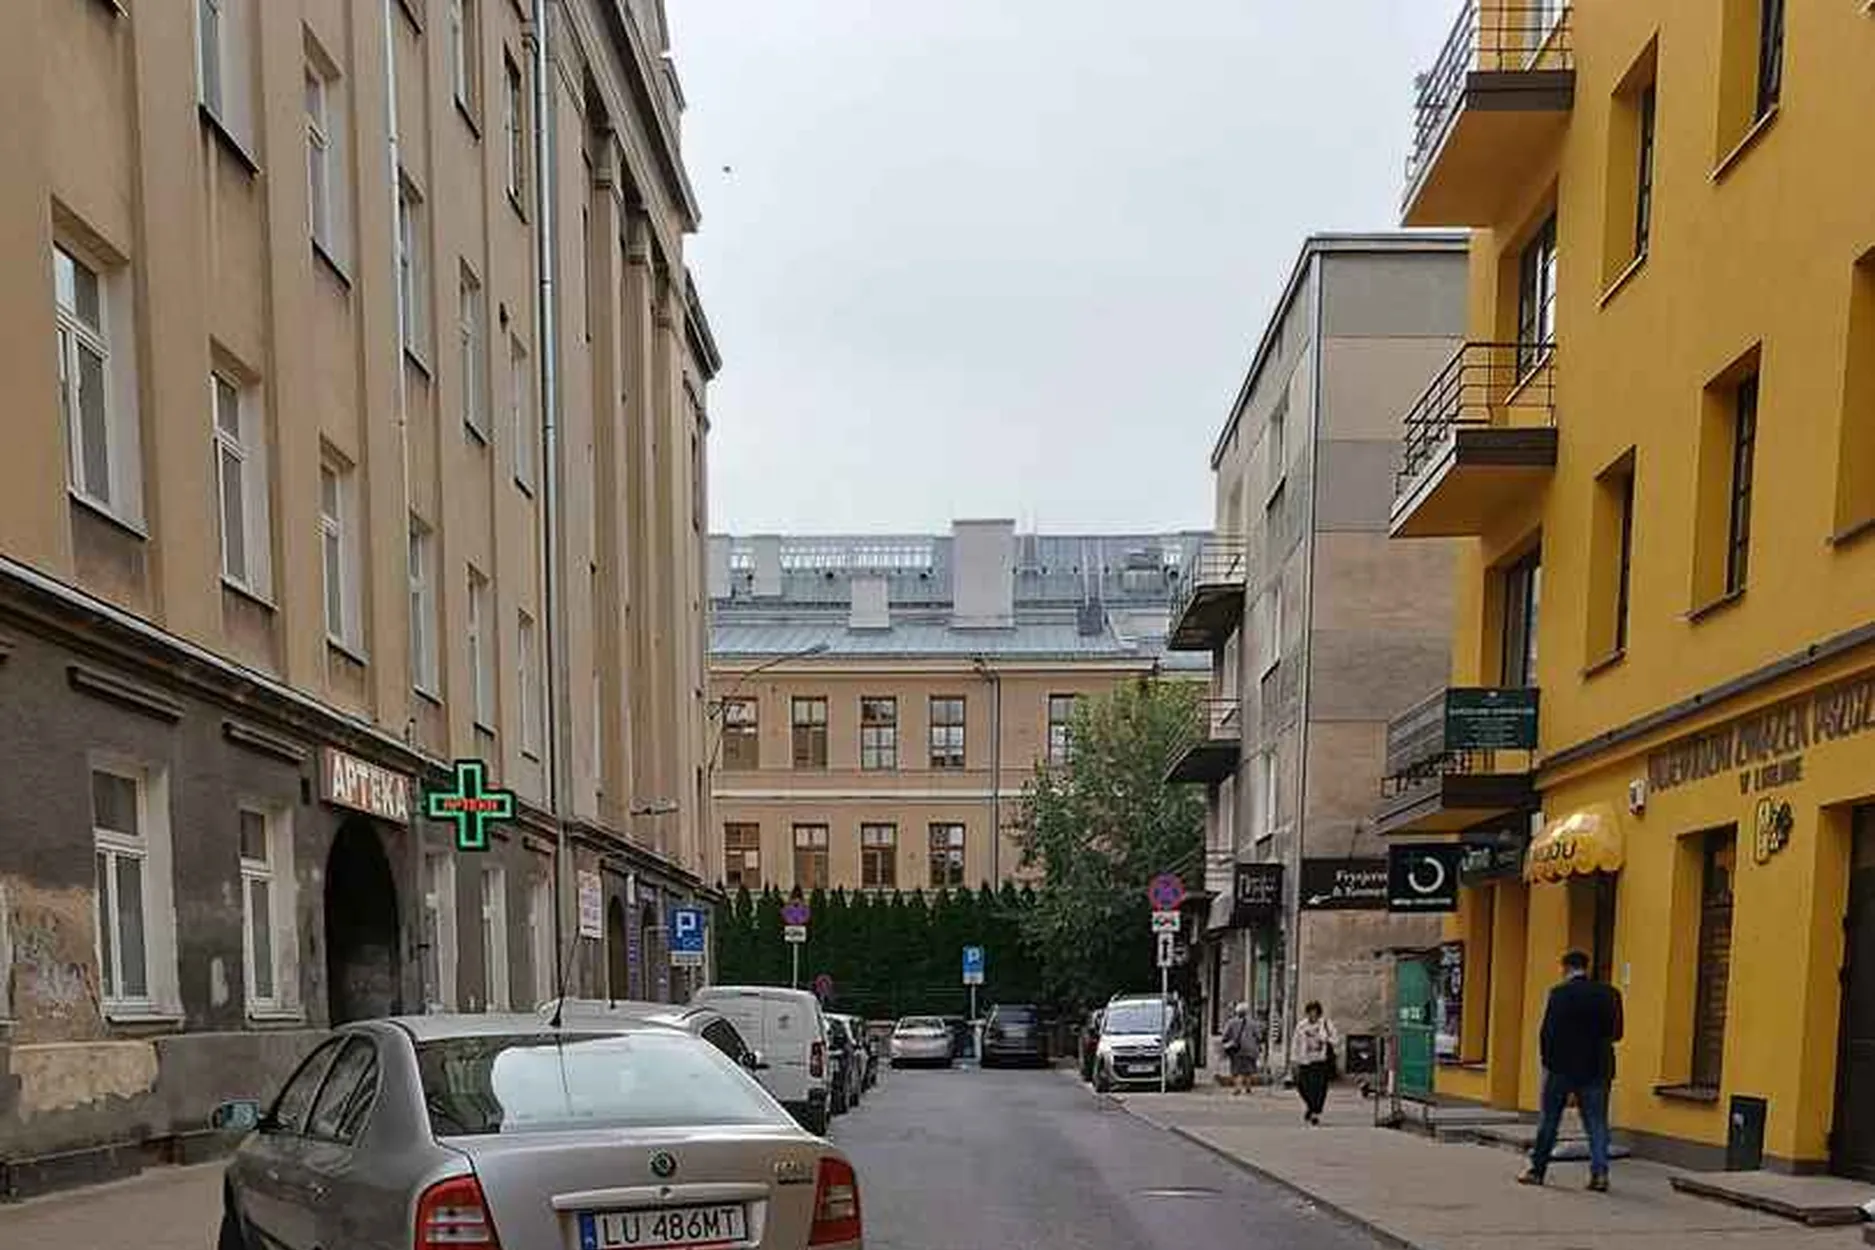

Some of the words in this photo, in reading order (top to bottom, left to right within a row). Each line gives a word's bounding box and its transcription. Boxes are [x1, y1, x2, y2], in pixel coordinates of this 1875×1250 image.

[333, 752, 409, 822] APTEKA
[676, 911, 697, 938] P
[602, 1212, 641, 1246] LU
[651, 1207, 739, 1242] 486MT
